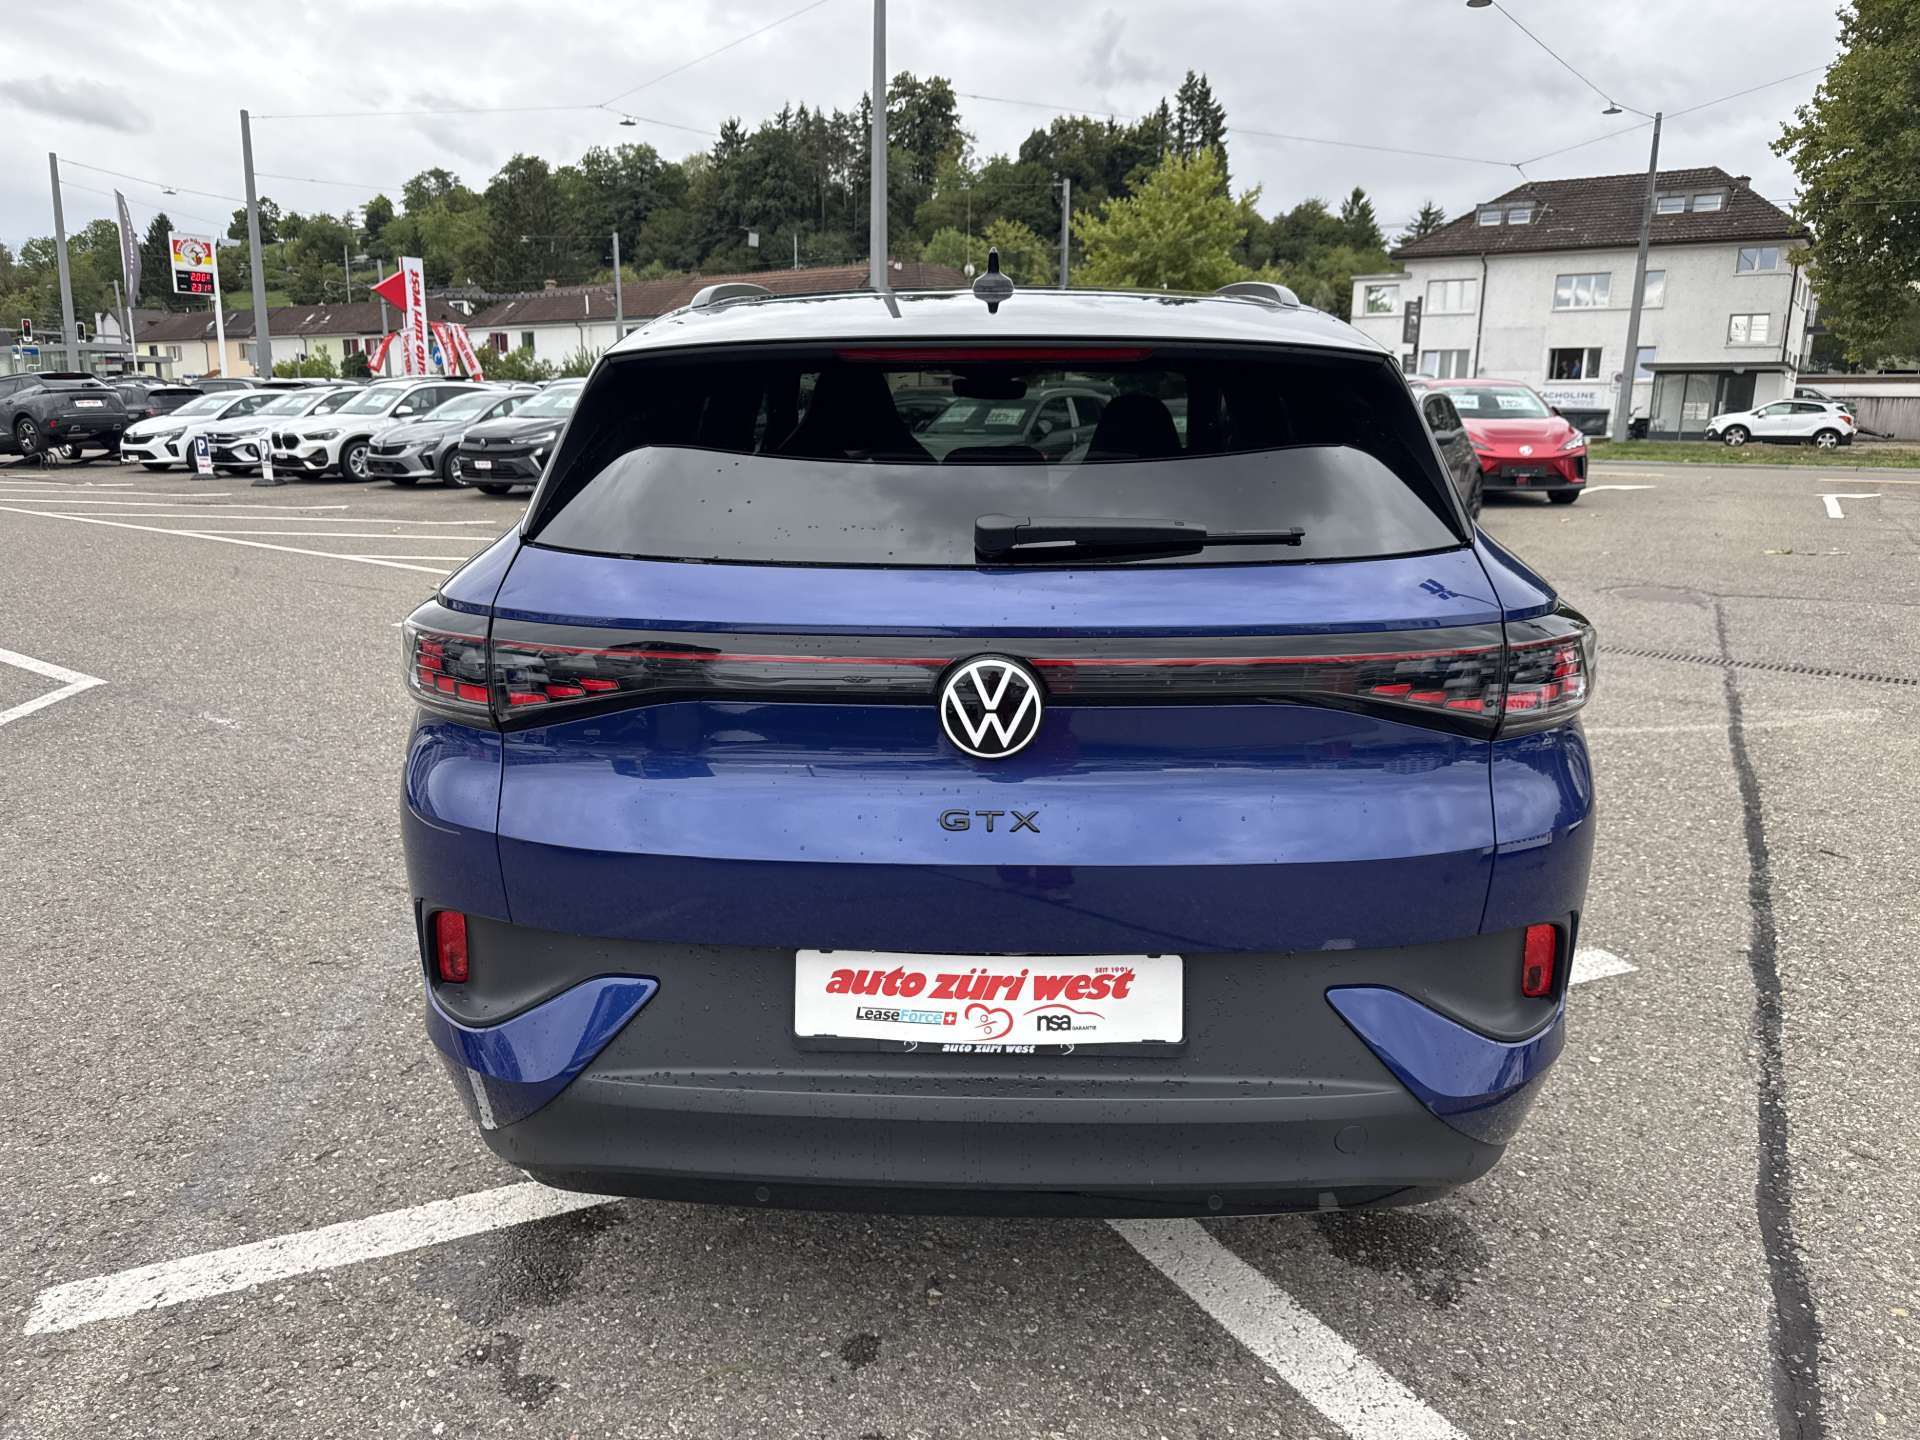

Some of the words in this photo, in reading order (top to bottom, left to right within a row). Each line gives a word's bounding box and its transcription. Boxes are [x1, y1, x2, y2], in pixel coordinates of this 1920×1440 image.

[410, 269, 421, 307] west
[197, 438, 206, 454] P
[262, 440, 269, 460] P
[939, 808, 1041, 833] GTX
[826, 965, 927, 997] auto
[929, 967, 1032, 1001] züri
[1033, 967, 1136, 1001] west
[856, 1006, 943, 1025] LeaseForce
[1037, 1013, 1072, 1031] nsa
[942, 1043, 972, 1053] auto
[1006, 1044, 1036, 1054] west
